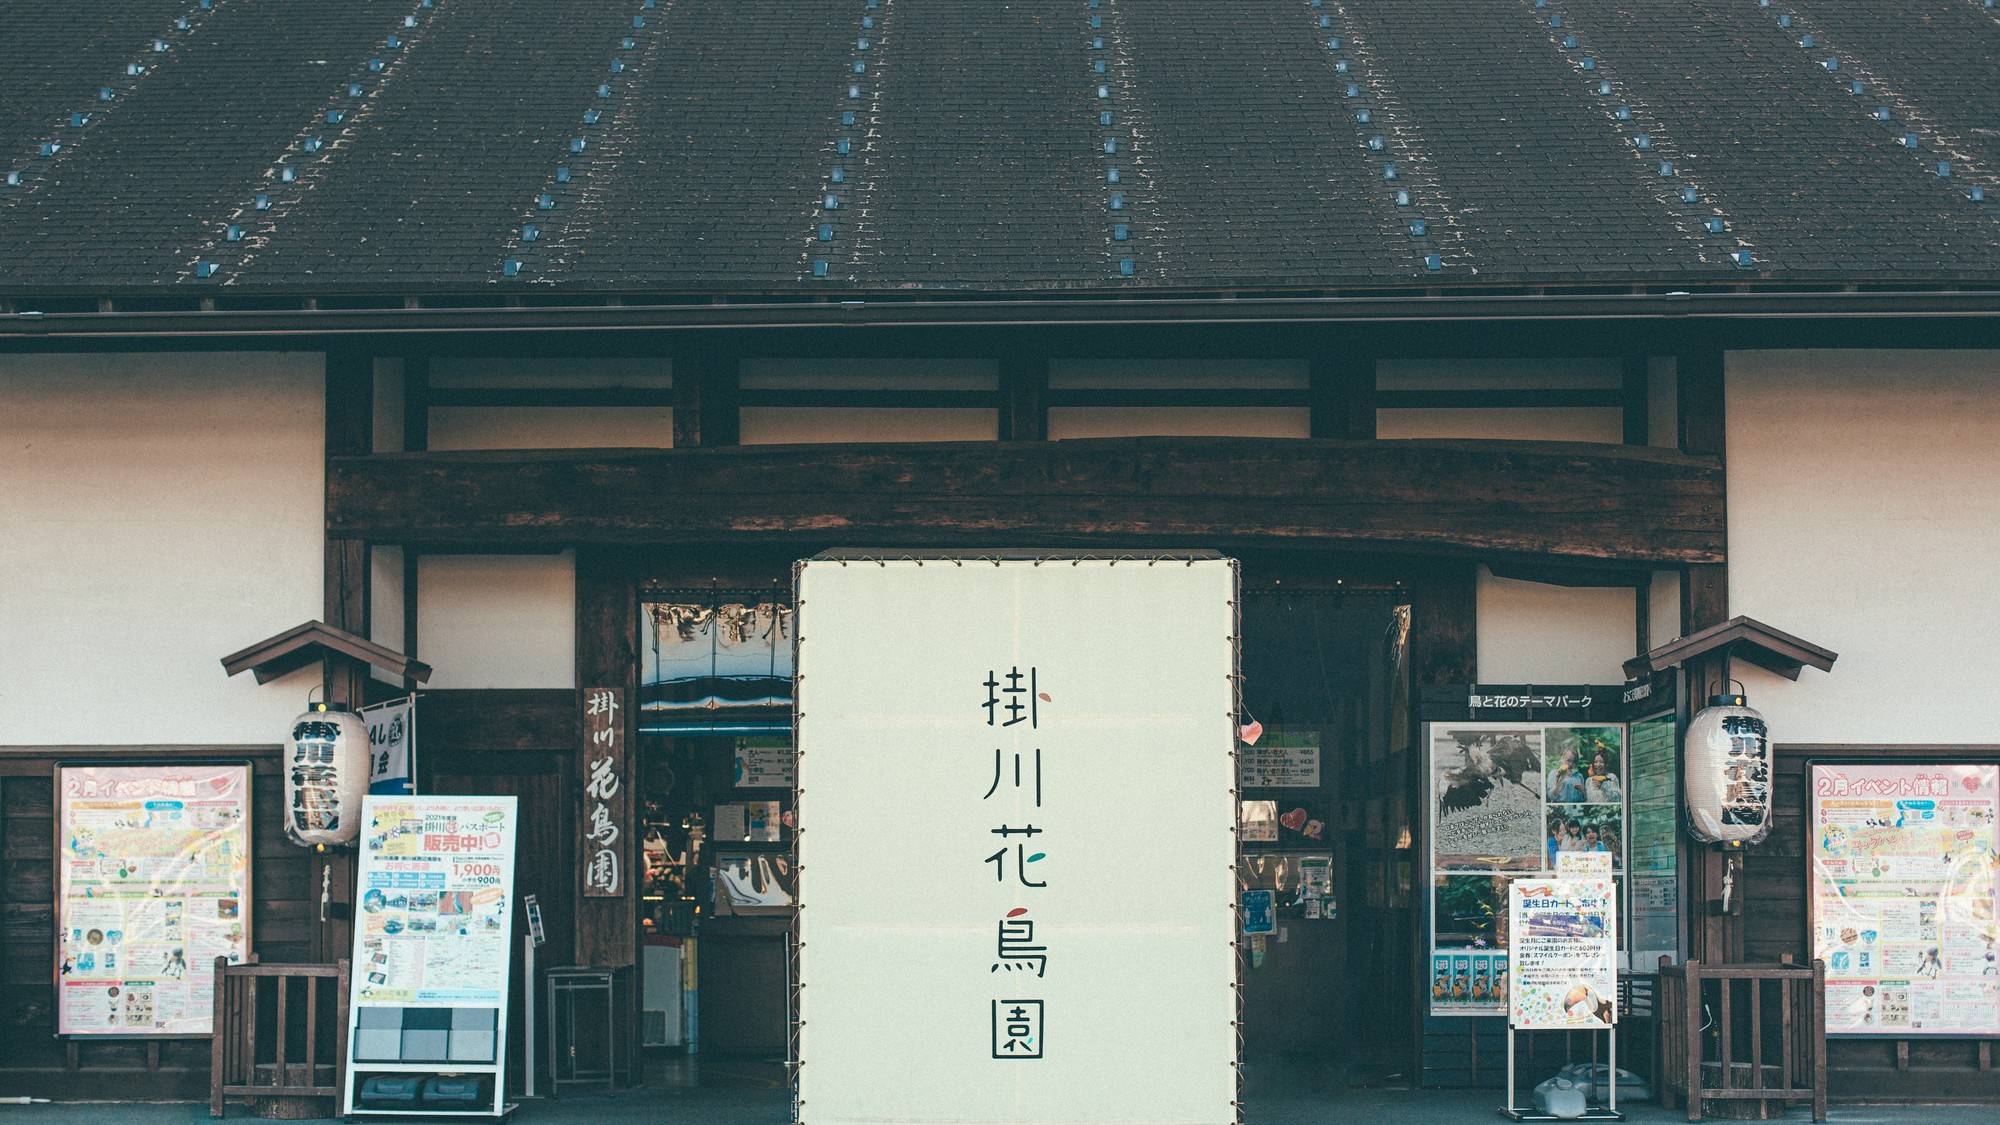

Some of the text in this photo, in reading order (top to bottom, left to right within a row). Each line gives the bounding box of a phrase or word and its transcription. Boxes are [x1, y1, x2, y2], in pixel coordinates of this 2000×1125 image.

[1469, 694, 1592, 708] 鳥と花のテーマパーク
[586, 690, 619, 894] 掛川花鳥園
[1817, 777, 1949, 797] 2月イベント情報
[981, 665, 1052, 1060] 掛川花鳥園
